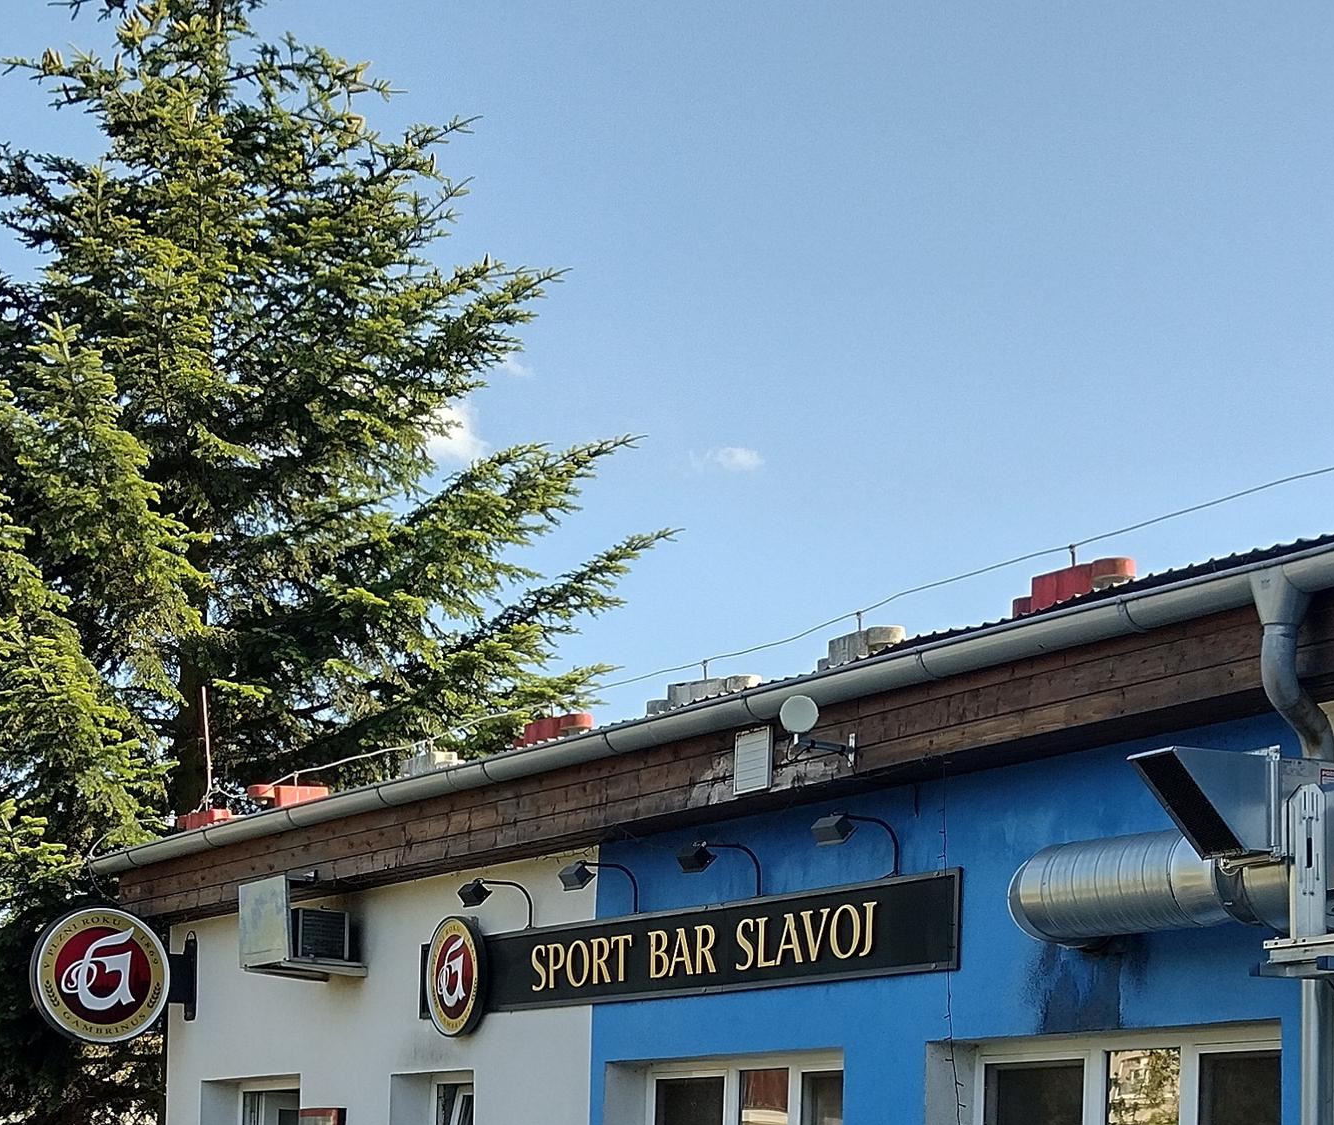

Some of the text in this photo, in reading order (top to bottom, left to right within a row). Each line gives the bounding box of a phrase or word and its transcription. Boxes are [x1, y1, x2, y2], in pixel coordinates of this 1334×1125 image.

[43, 916, 159, 969] V PLZNI ROKU 1869
[531, 934, 632, 992] SPORT
[647, 924, 716, 979] BAR
[735, 901, 878, 971] SLAVOJ
[62, 1011, 146, 1035] GAMBRINUS
